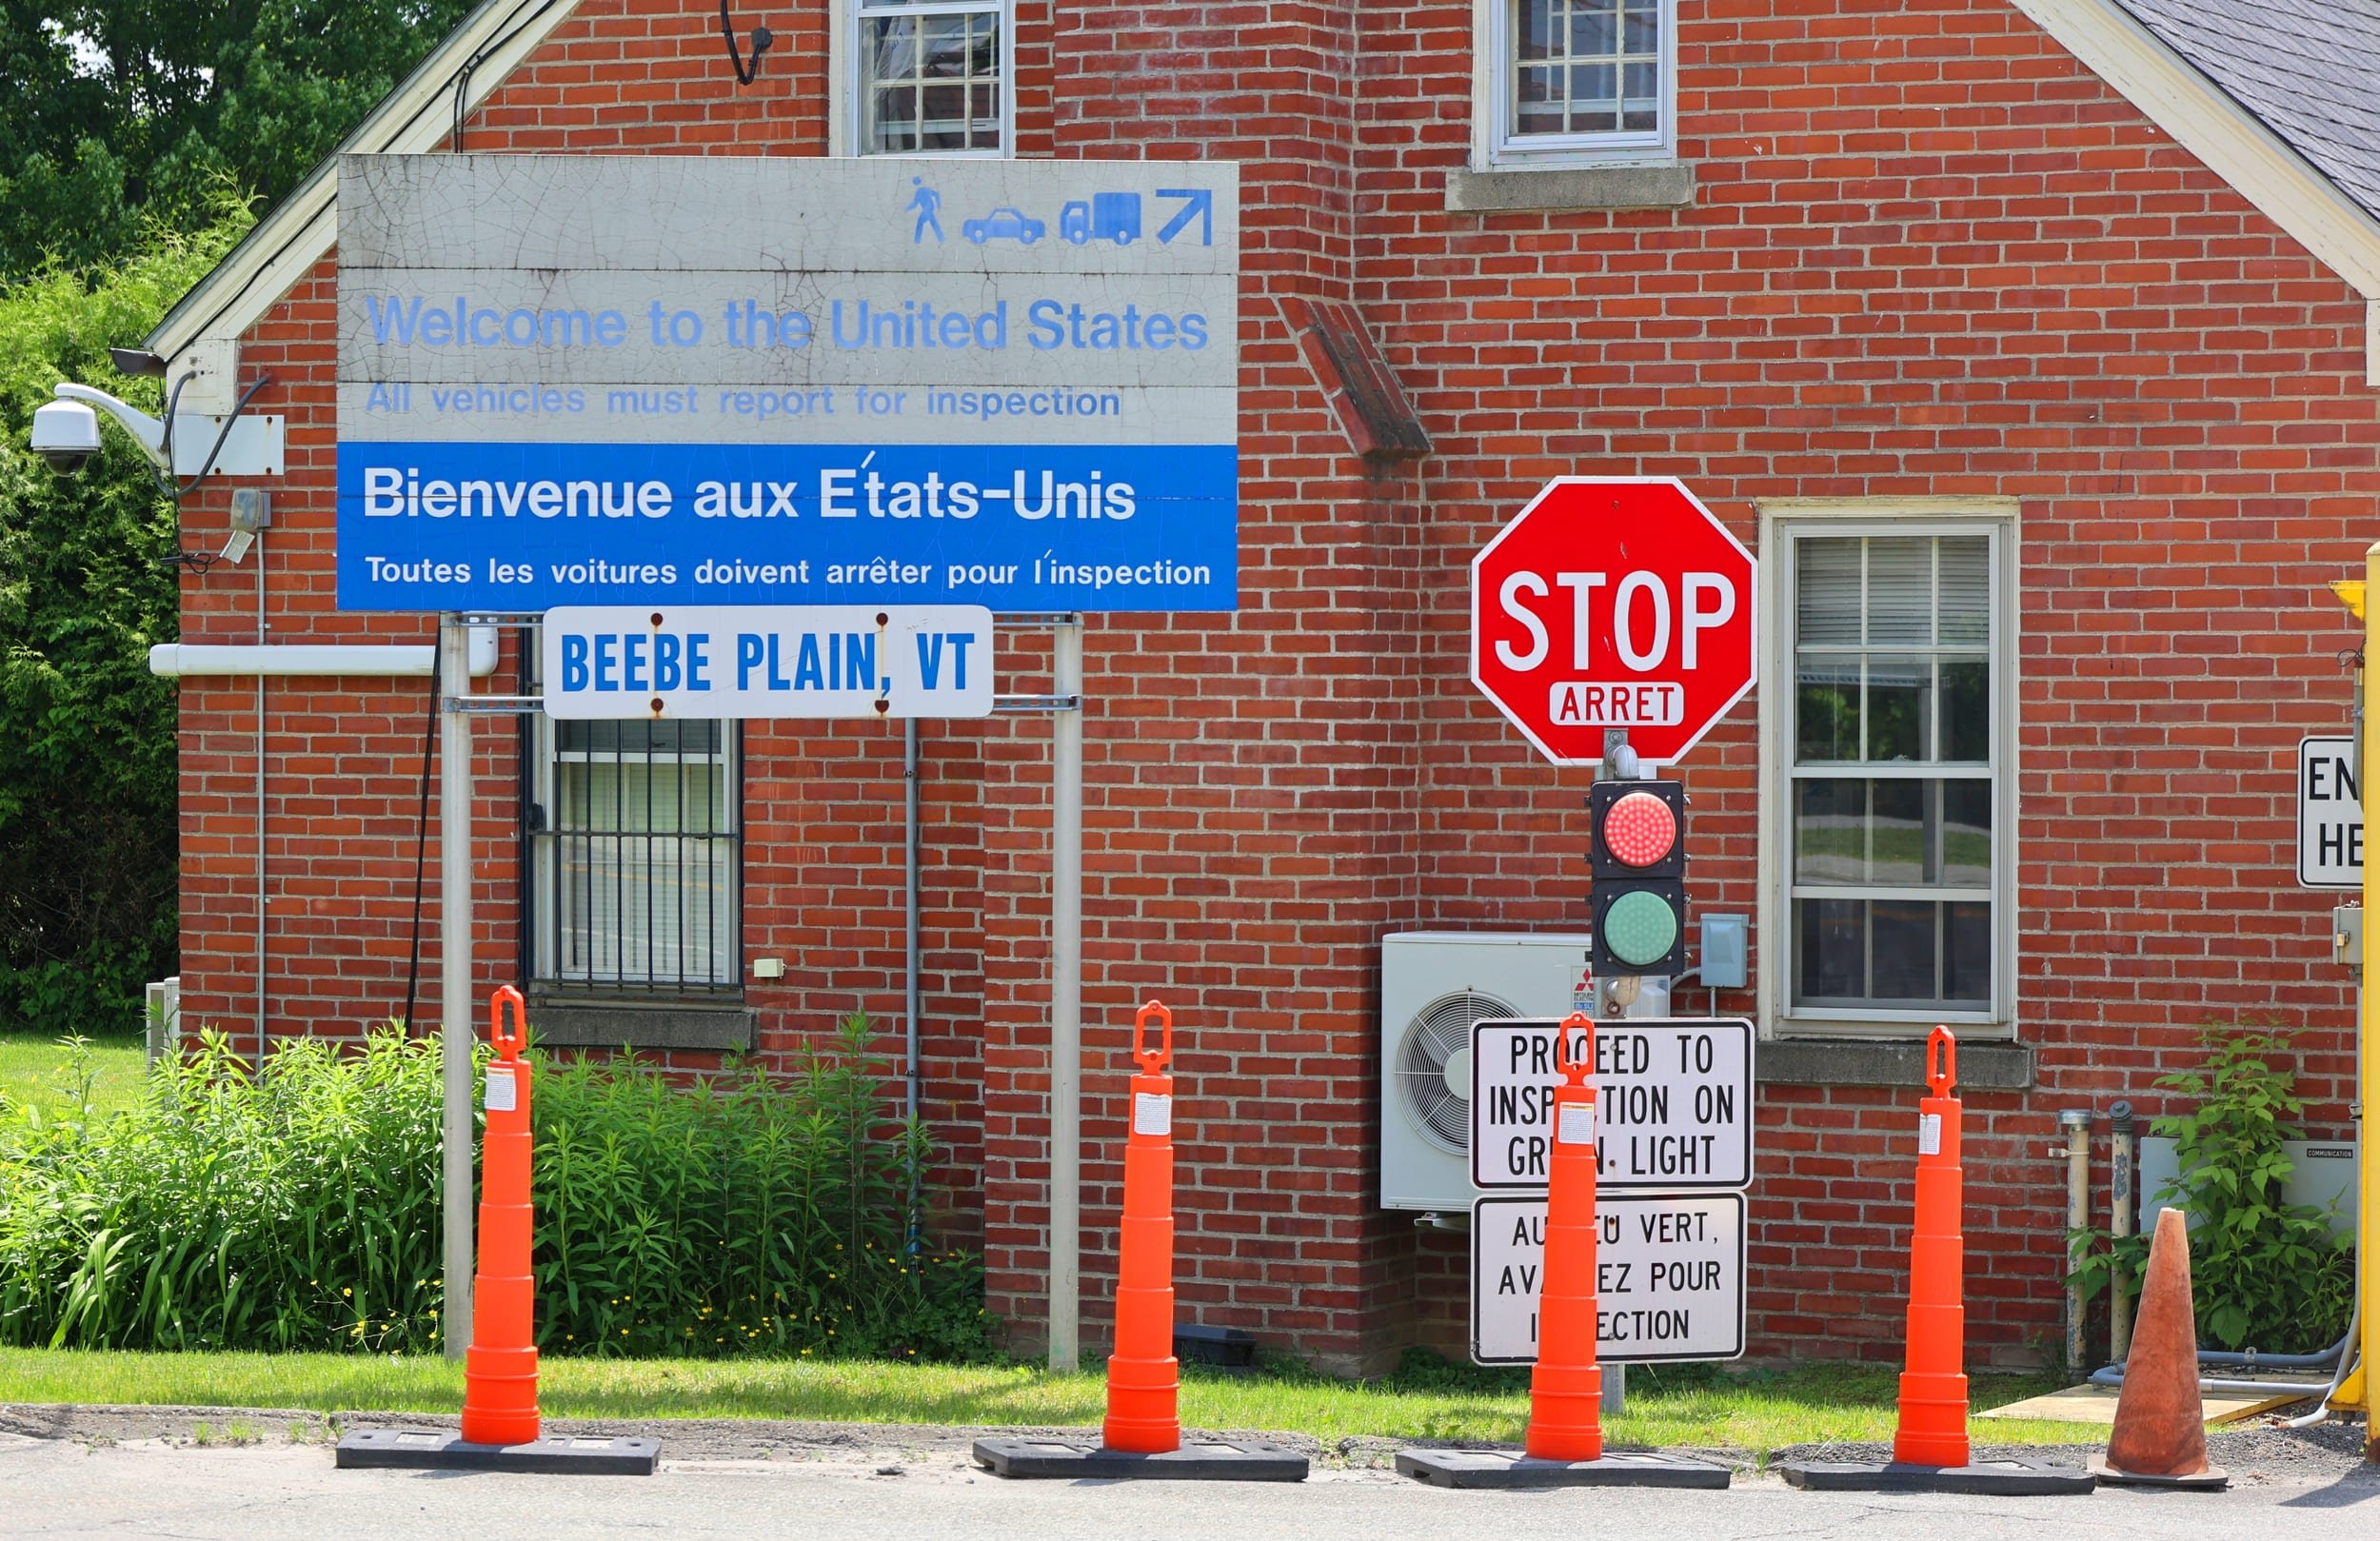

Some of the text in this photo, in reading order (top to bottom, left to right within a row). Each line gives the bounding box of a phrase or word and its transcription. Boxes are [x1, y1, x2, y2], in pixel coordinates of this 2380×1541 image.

[366, 296, 1209, 350] Welcome to the United States
[366, 384, 1120, 422] All vehicles must report for inspection
[365, 467, 672, 518] Bienvenue
[694, 482, 798, 519] aux
[366, 557, 470, 583] Toutes
[489, 558, 533, 583] les
[552, 559, 676, 583] voitures
[695, 559, 808, 583] doivent
[827, 557, 931, 584] arrêter
[949, 565, 1018, 588] pour
[1496, 570, 1735, 671] STOP
[561, 632, 976, 699] BEEBE PLAIN, VT
[1559, 686, 1675, 721] ARRET
[1677, 1036, 1713, 1074] TO
[1490, 1086, 1667, 1124] INSPTION
[1696, 1086, 1734, 1124] ON
[1509, 1136, 1715, 1175] GRN LIGHT
[1641, 1213, 1718, 1244] VERT,
[1498, 1262, 1720, 1294] AVEZ POUR
[1531, 1310, 1689, 1341] IECTION
